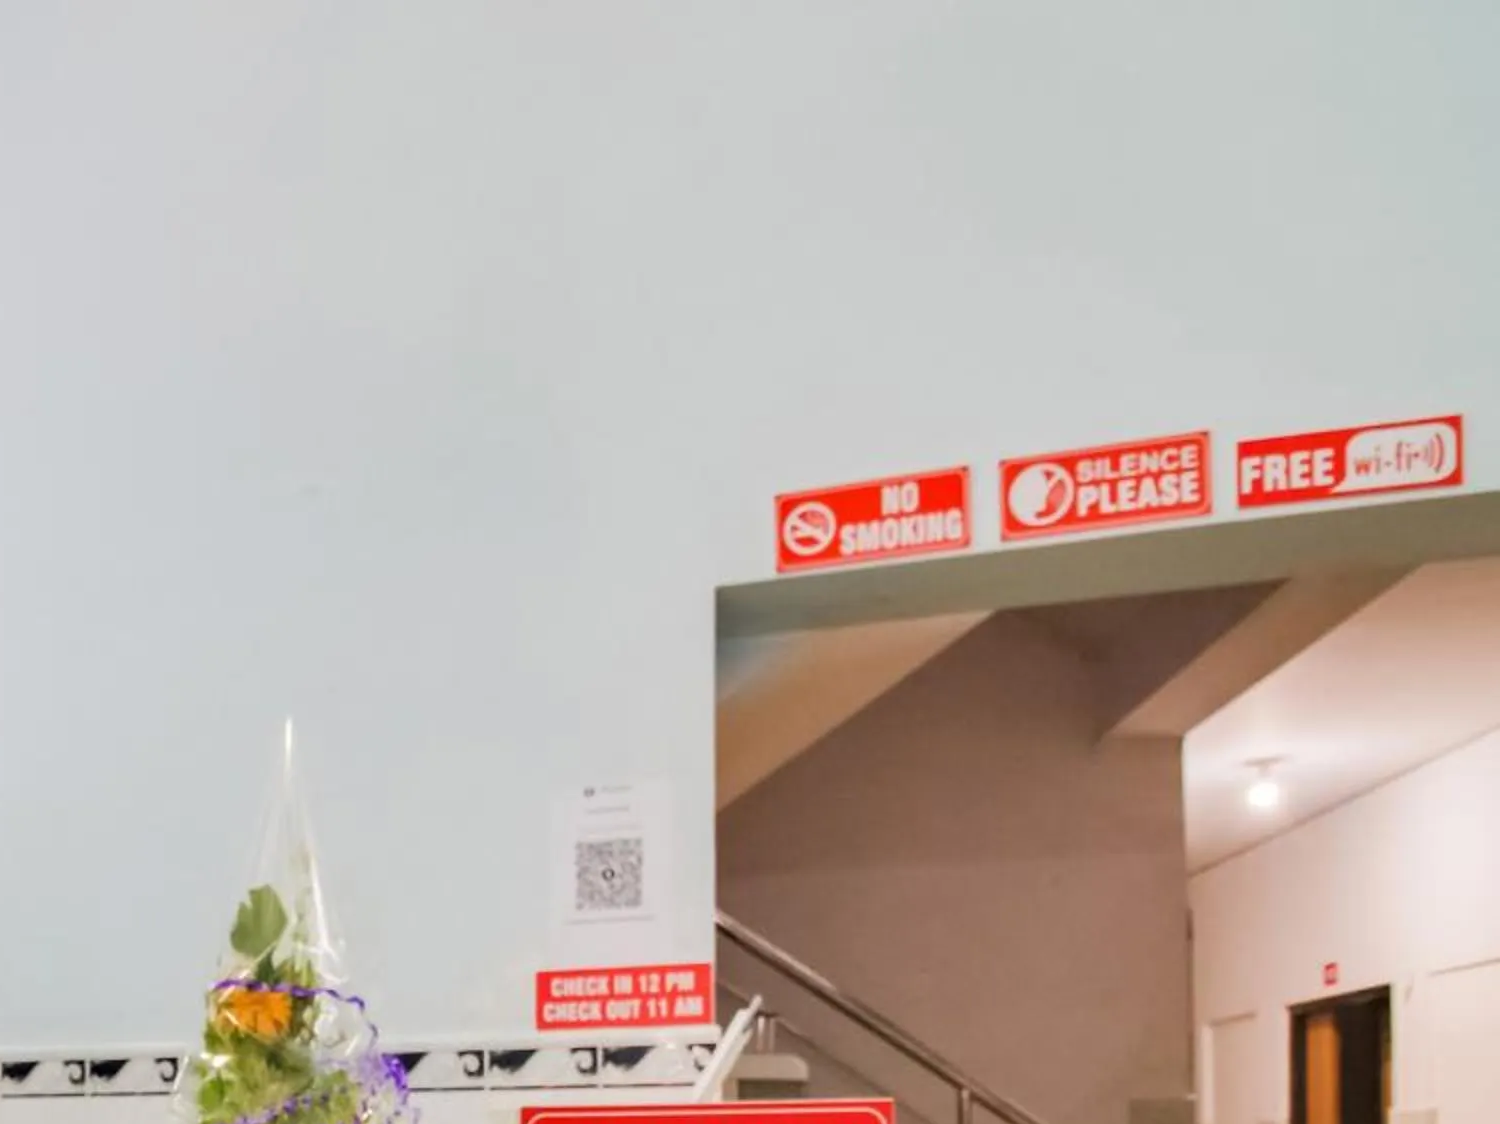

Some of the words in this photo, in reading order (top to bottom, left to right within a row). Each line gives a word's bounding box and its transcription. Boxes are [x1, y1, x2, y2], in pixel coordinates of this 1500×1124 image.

[1075, 444, 1200, 483] SILENCE
[1240, 448, 1335, 495] FREE
[880, 481, 920, 515] NO
[1076, 470, 1201, 517] PLEASE
[839, 507, 963, 555] SMOKING
[550, 976, 610, 998] CHECK
[613, 974, 633, 994] IN
[639, 972, 661, 993] 12
[665, 971, 696, 992] PM
[542, 1000, 602, 1023] CHECK
[605, 998, 641, 1020] OUT
[643, 997, 668, 1019] 11
[673, 996, 704, 1017] AM
